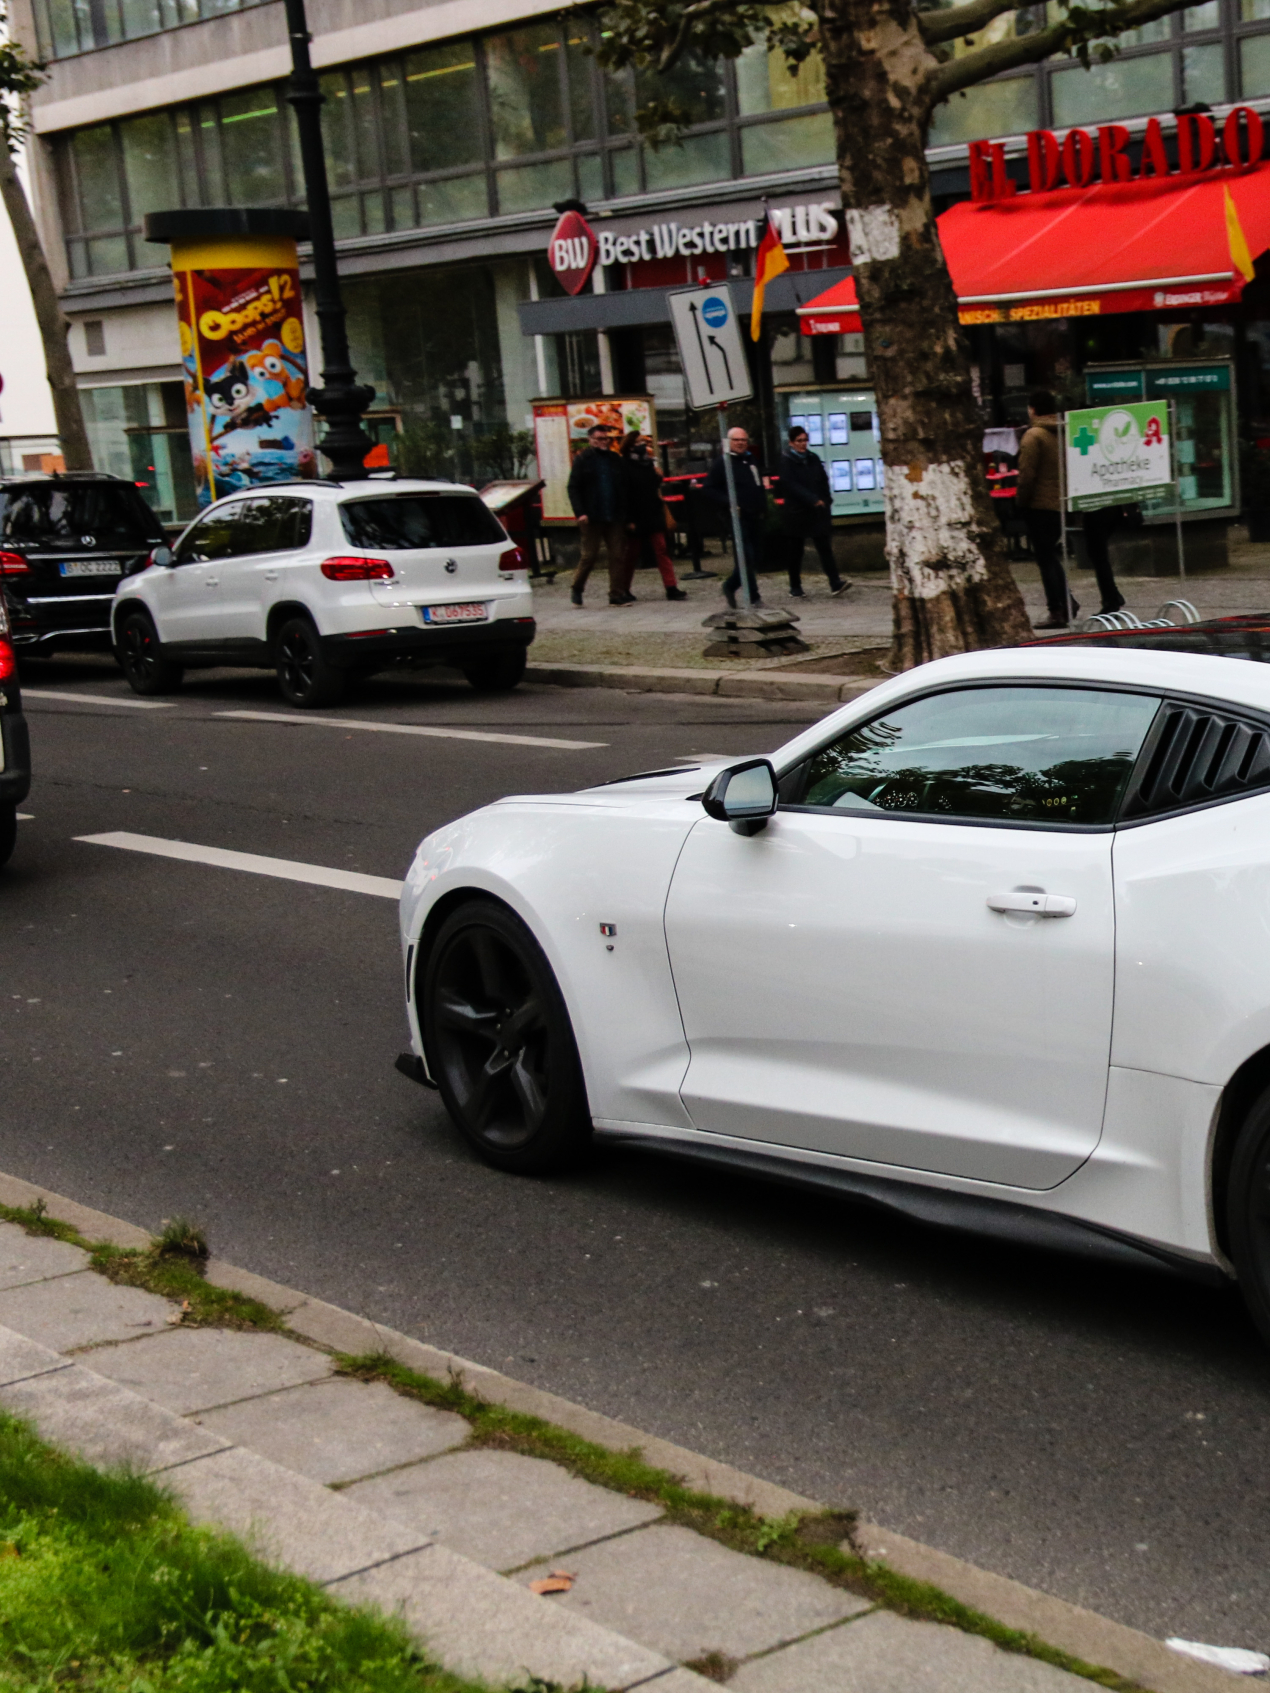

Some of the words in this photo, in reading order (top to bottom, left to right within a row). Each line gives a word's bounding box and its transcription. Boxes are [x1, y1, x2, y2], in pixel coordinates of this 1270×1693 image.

[968, 140, 1017, 201] EL
[1026, 106, 1265, 195] DORADO
[554, 235, 589, 272] BW
[600, 229, 651, 267] Best
[653, 219, 757, 259] Western
[1009, 299, 1100, 321] SPEZIALITÄTEN
[1091, 454, 1151, 478] Apotheke
